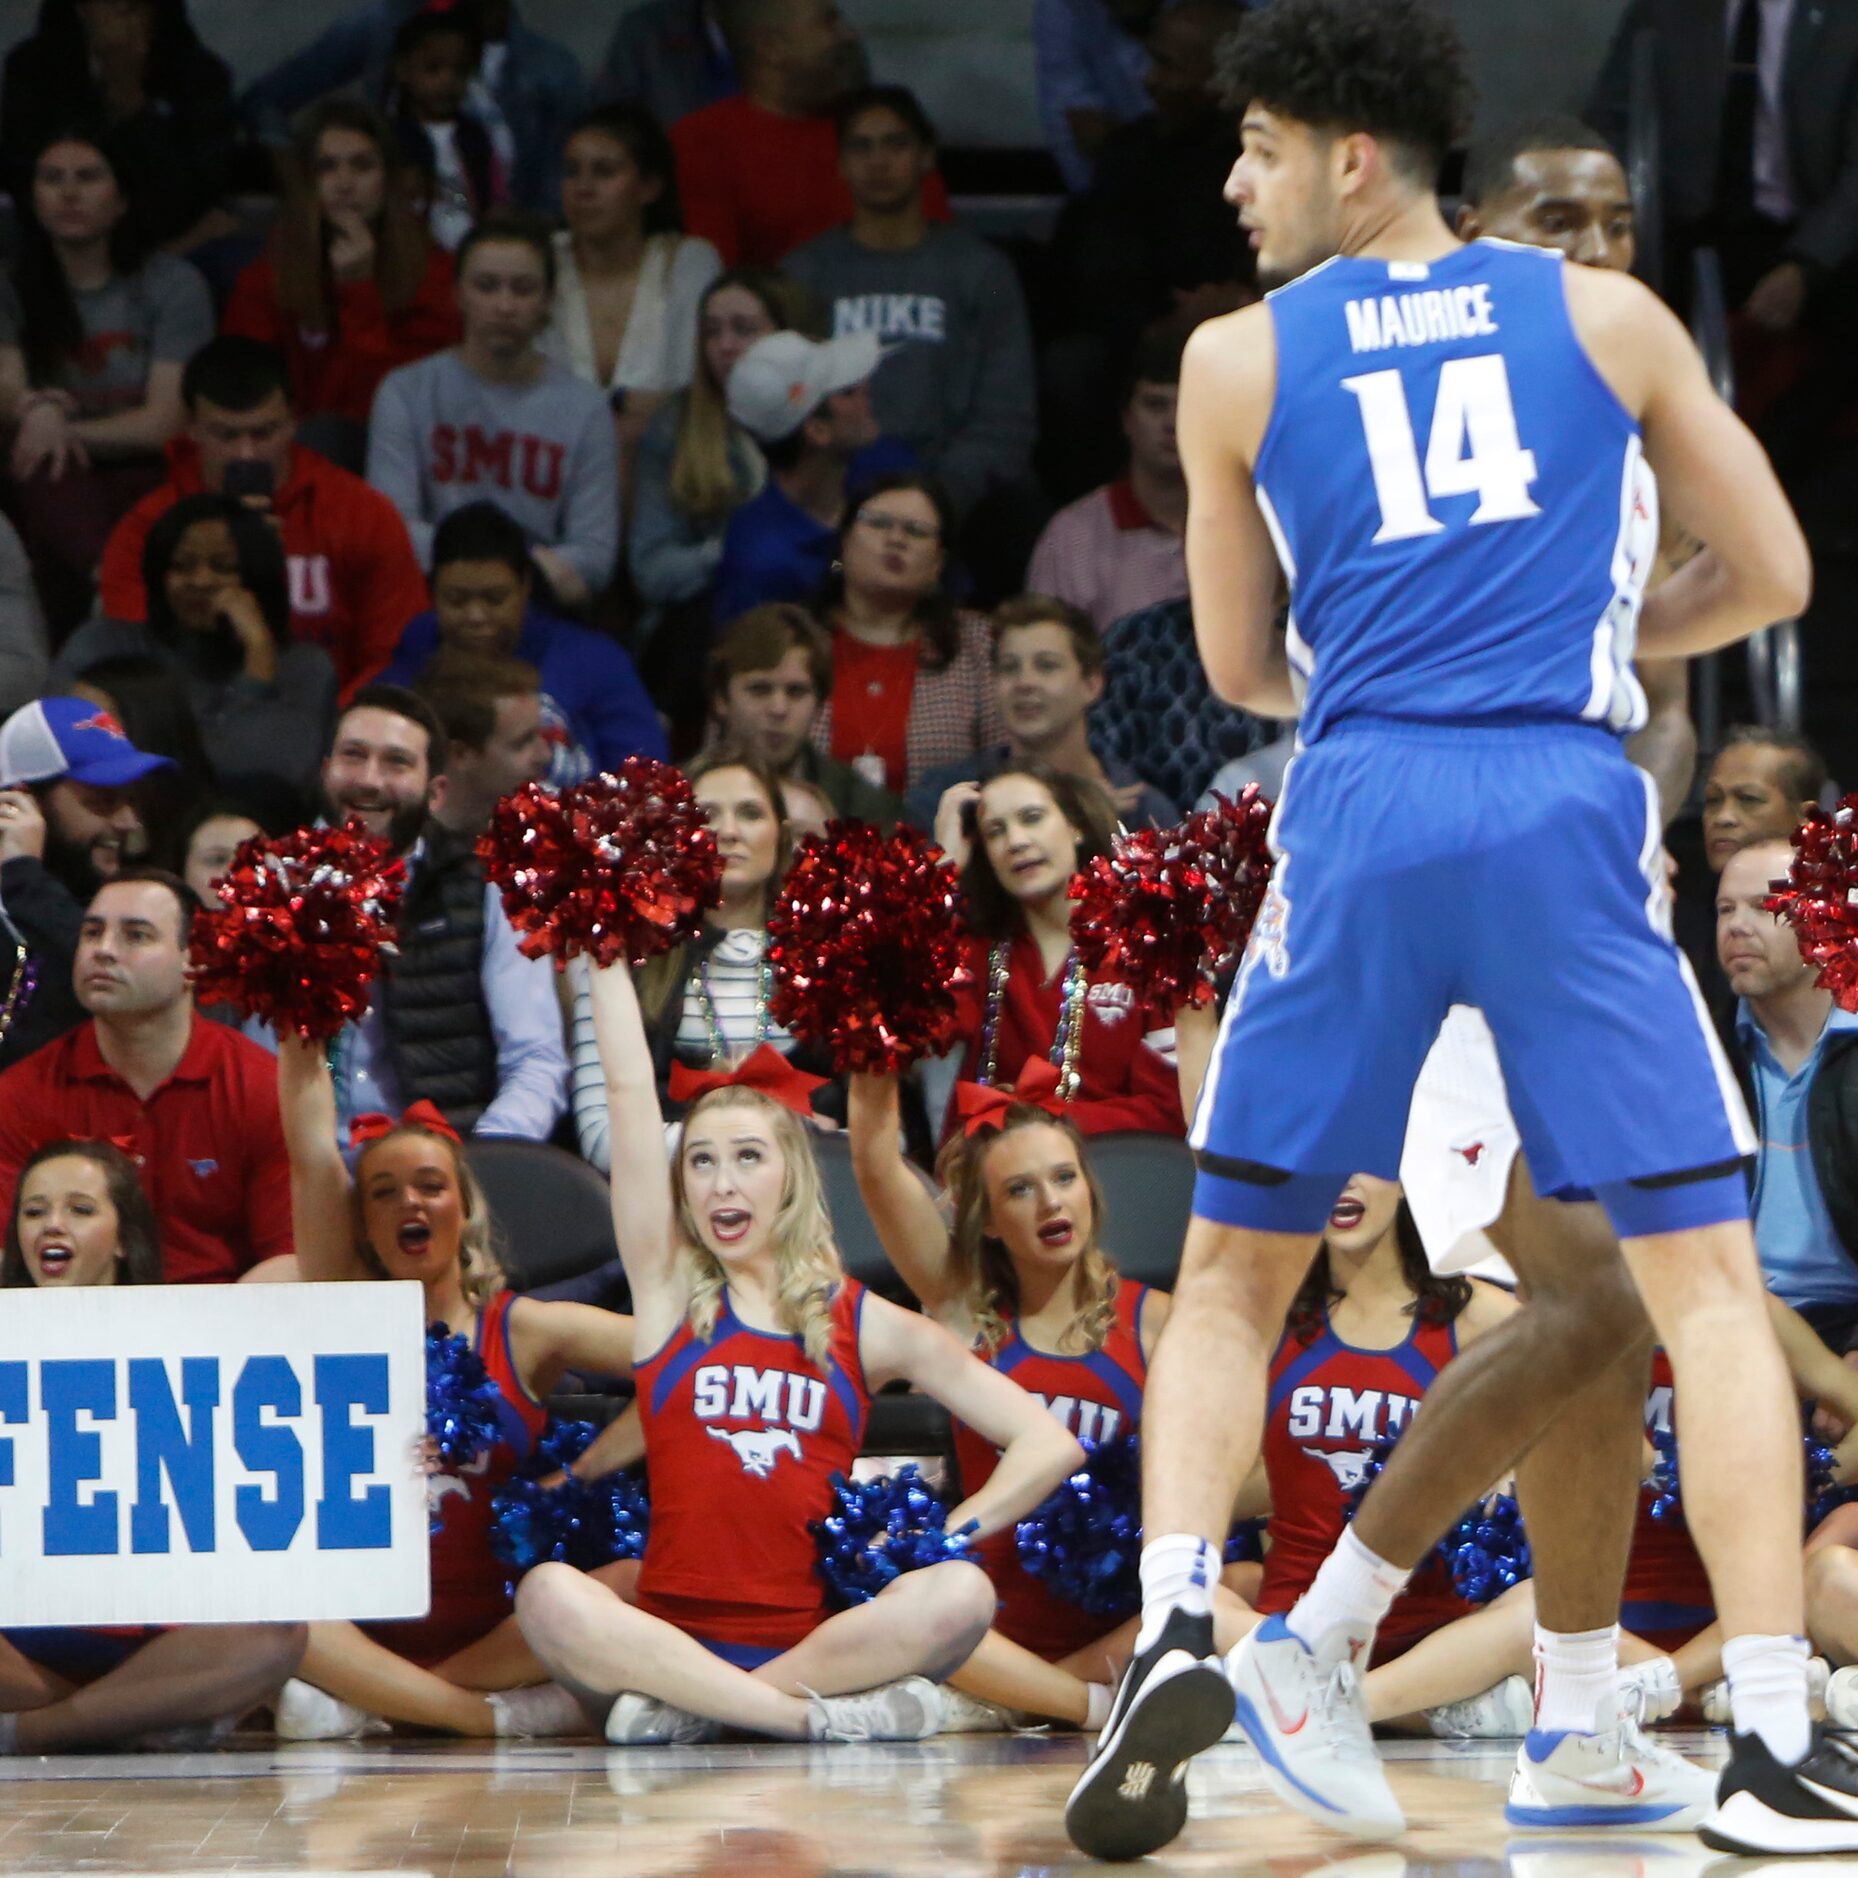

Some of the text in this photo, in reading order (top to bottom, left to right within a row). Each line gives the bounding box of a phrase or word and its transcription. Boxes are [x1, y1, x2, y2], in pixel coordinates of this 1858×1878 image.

[833, 293, 947, 340] NIKE
[1344, 283, 1498, 354] MAURICE
[431, 423, 567, 499] SMU
[1339, 353, 1542, 546] 14
[693, 1364, 828, 1431] SMU
